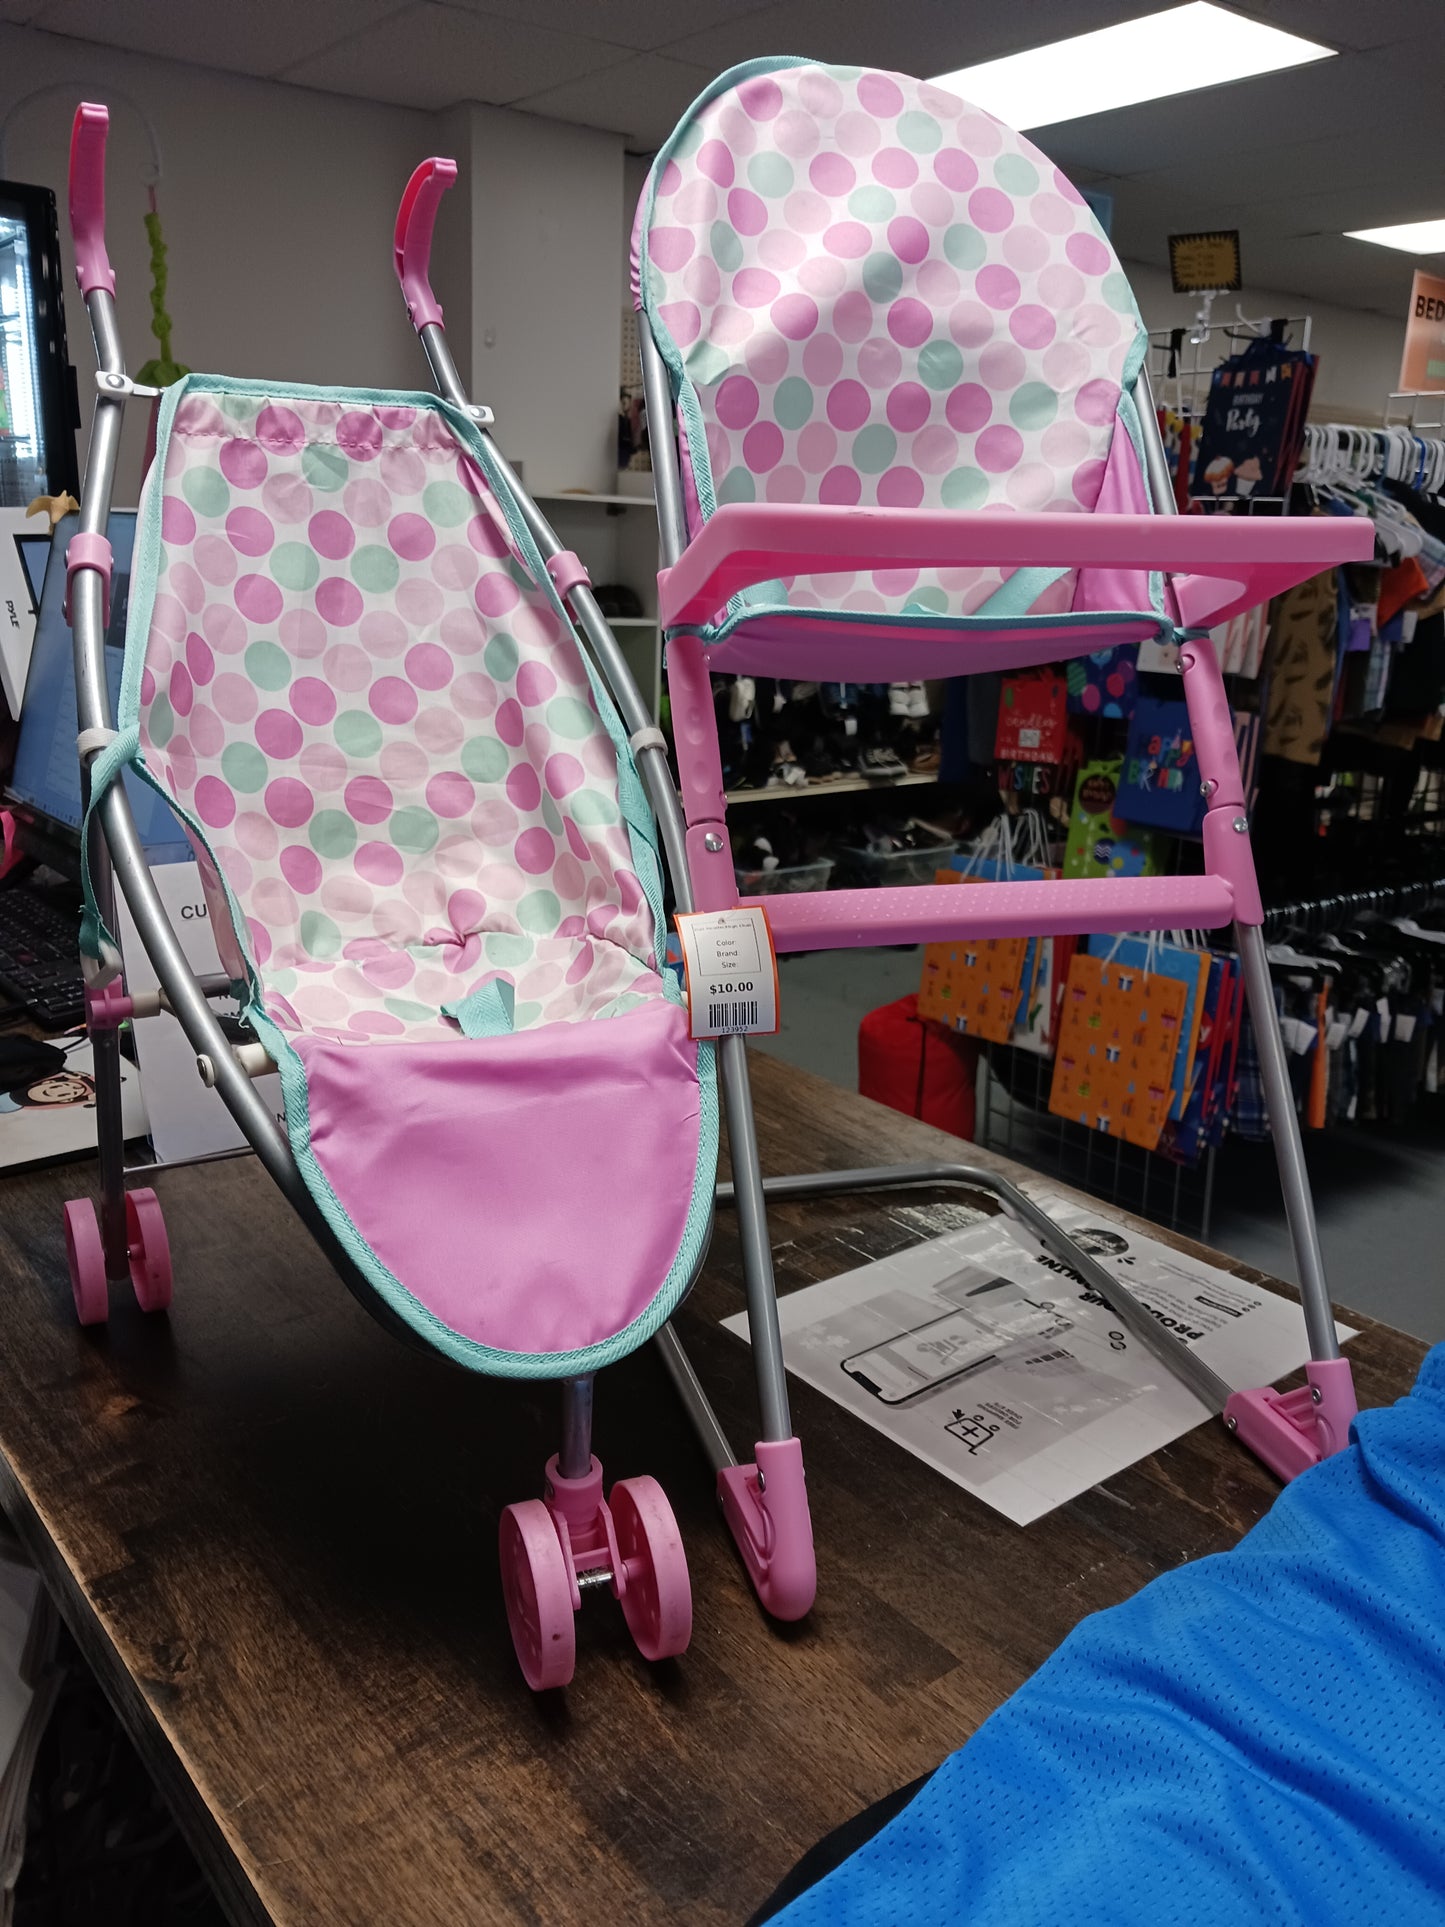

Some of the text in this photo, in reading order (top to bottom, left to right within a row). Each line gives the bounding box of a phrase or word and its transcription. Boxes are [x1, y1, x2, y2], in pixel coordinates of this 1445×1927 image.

[1226, 408, 1261, 438] Party
[5, 600, 20, 629] PYLE
[716, 939, 735, 947] Color
[716, 950, 738, 958] Brand
[721, 961, 737, 969] Size
[709, 982, 754, 995] $10.00
[722, 1025, 748, 1034] 123952
